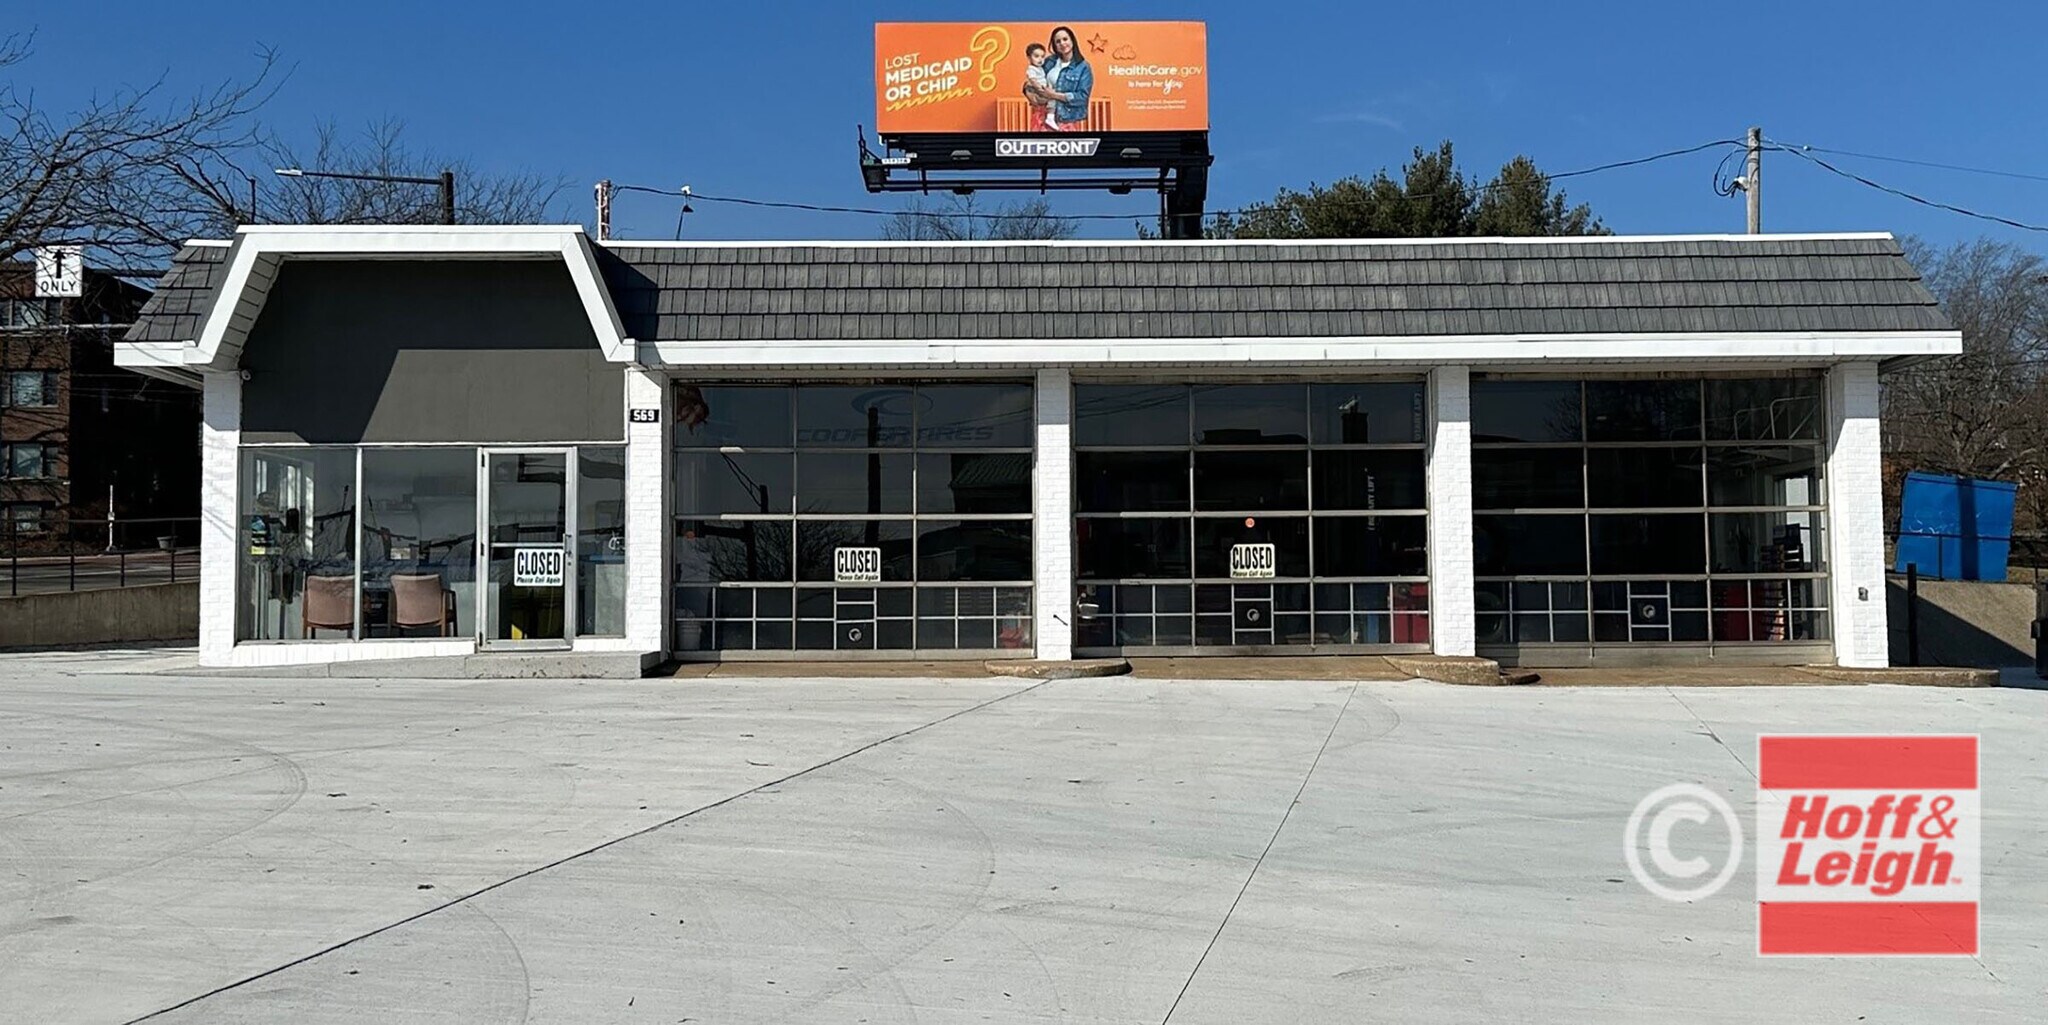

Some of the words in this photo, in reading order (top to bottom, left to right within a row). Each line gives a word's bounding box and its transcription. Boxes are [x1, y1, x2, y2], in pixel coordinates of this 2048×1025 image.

[884, 53, 920, 70] LOST
[885, 57, 973, 86] MEDICAID
[1108, 64, 1203, 78] HealthCare.gov
[885, 85, 912, 101] OR
[916, 76, 958, 95] CHIP
[1000, 140, 1094, 154] OUTFRONT
[40, 281, 77, 293] ONLY
[633, 410, 655, 421] 569
[517, 551, 560, 576] CLOSED
[837, 550, 878, 573] CLOSED
[1232, 546, 1272, 570] CLOSED
